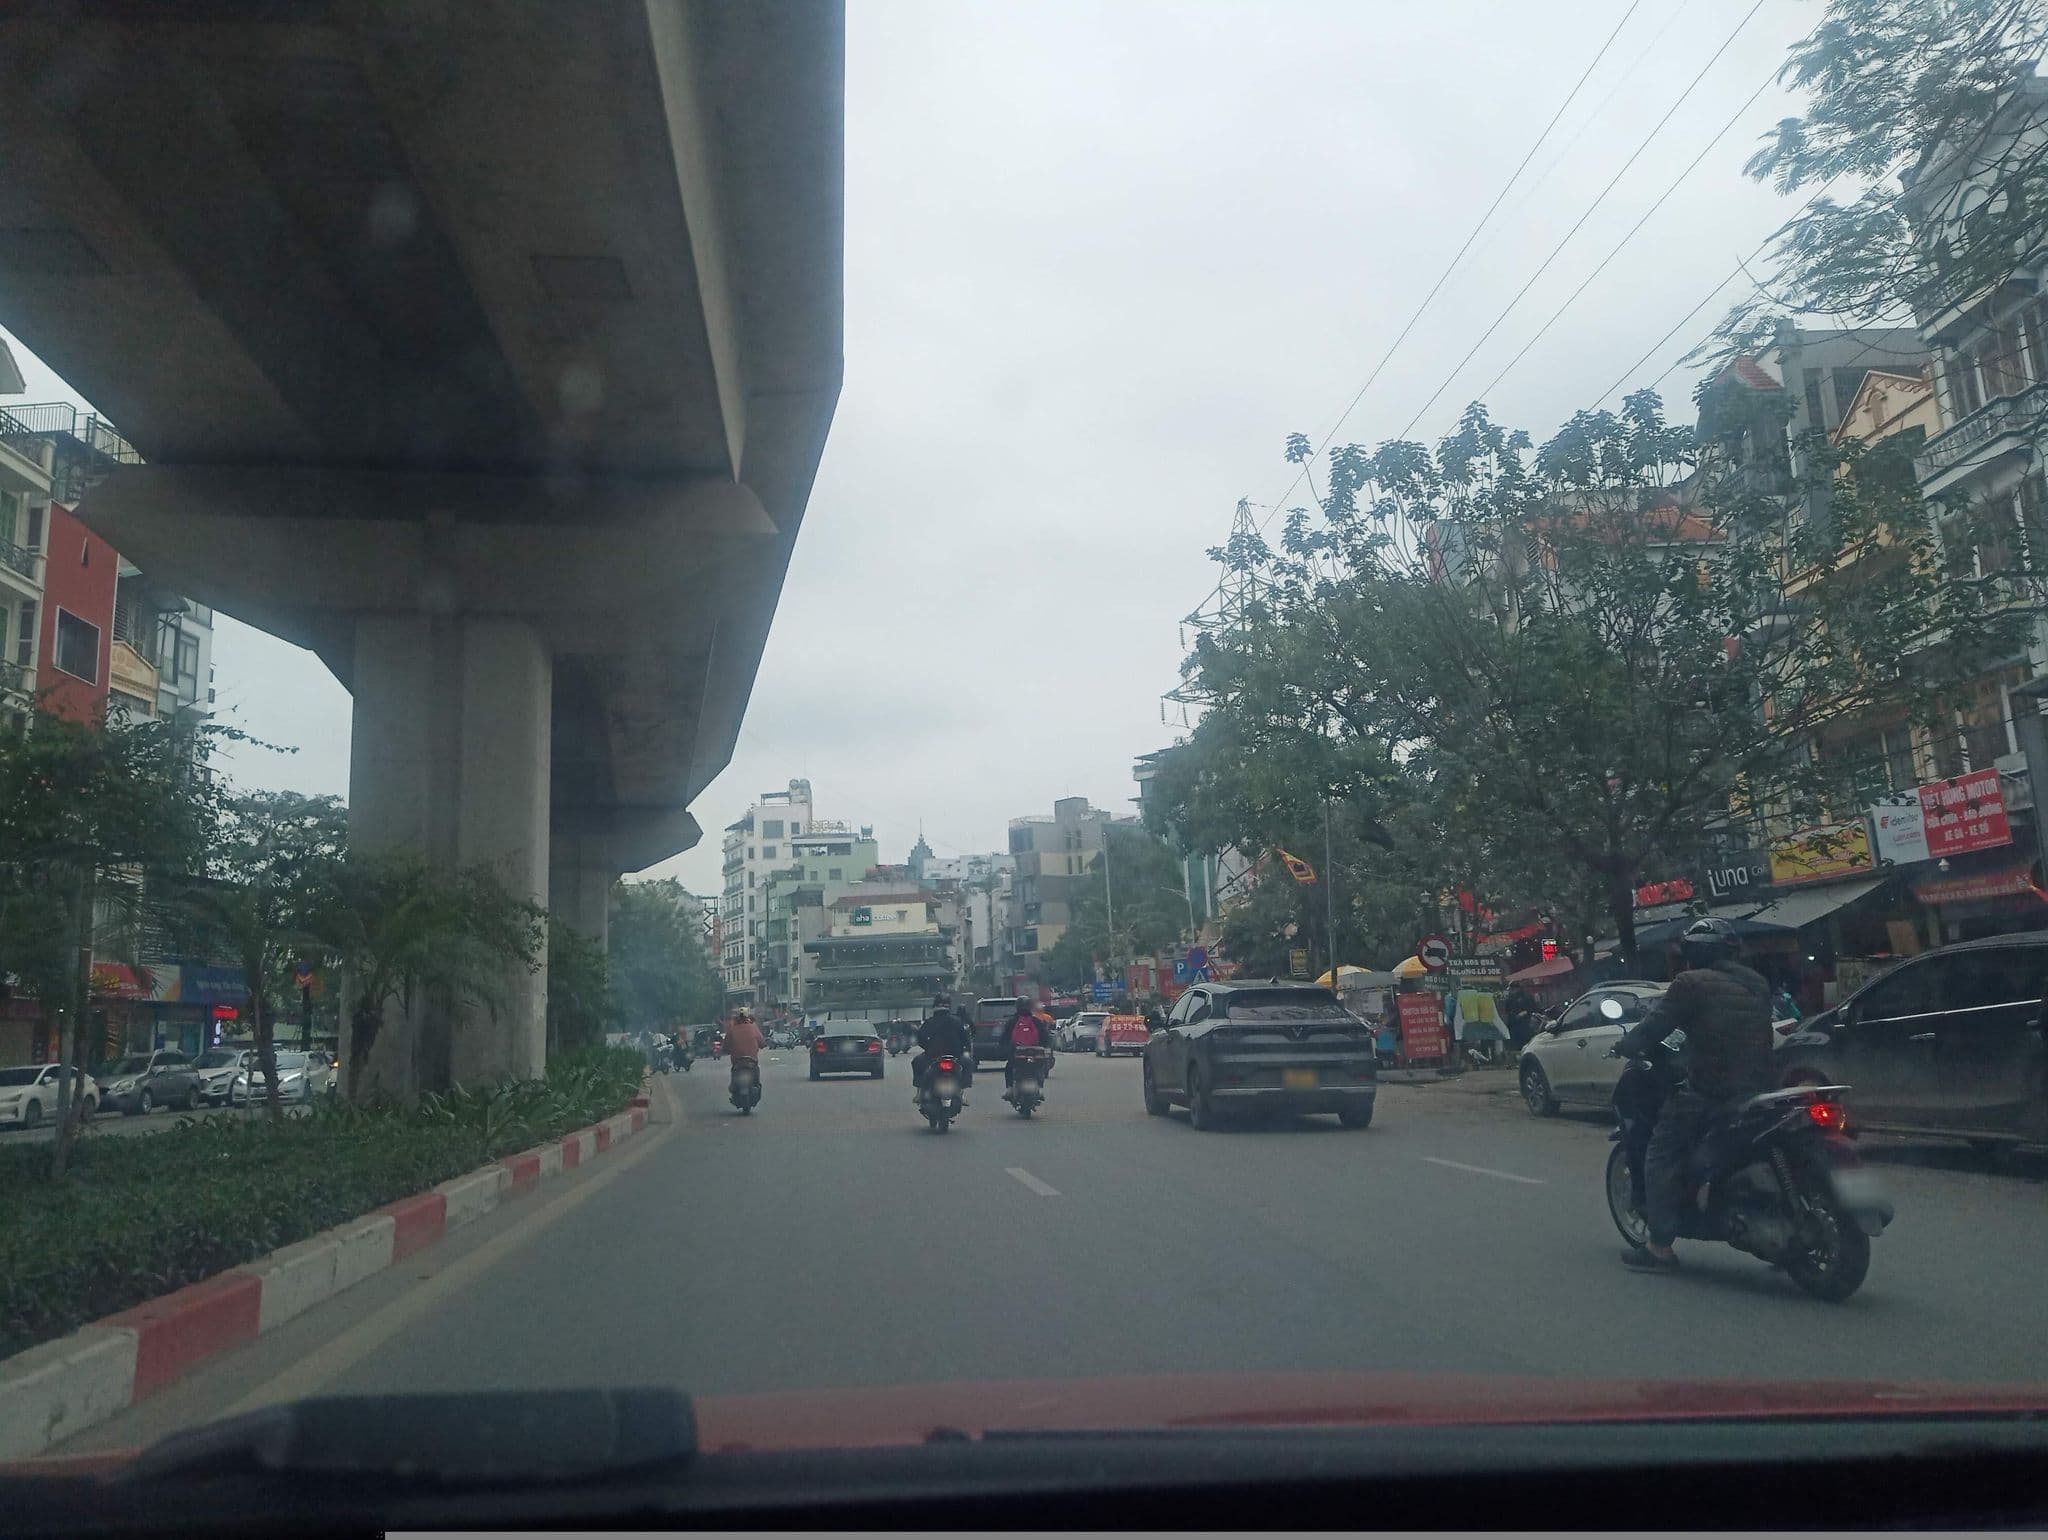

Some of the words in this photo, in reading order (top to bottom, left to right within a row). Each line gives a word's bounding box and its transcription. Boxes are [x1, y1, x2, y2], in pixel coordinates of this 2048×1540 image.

[1966, 778, 1998, 800] MOTOR
[1707, 866, 1749, 896] Luna
[855, 913, 870, 922] aha
[1177, 962, 1184, 974] P
